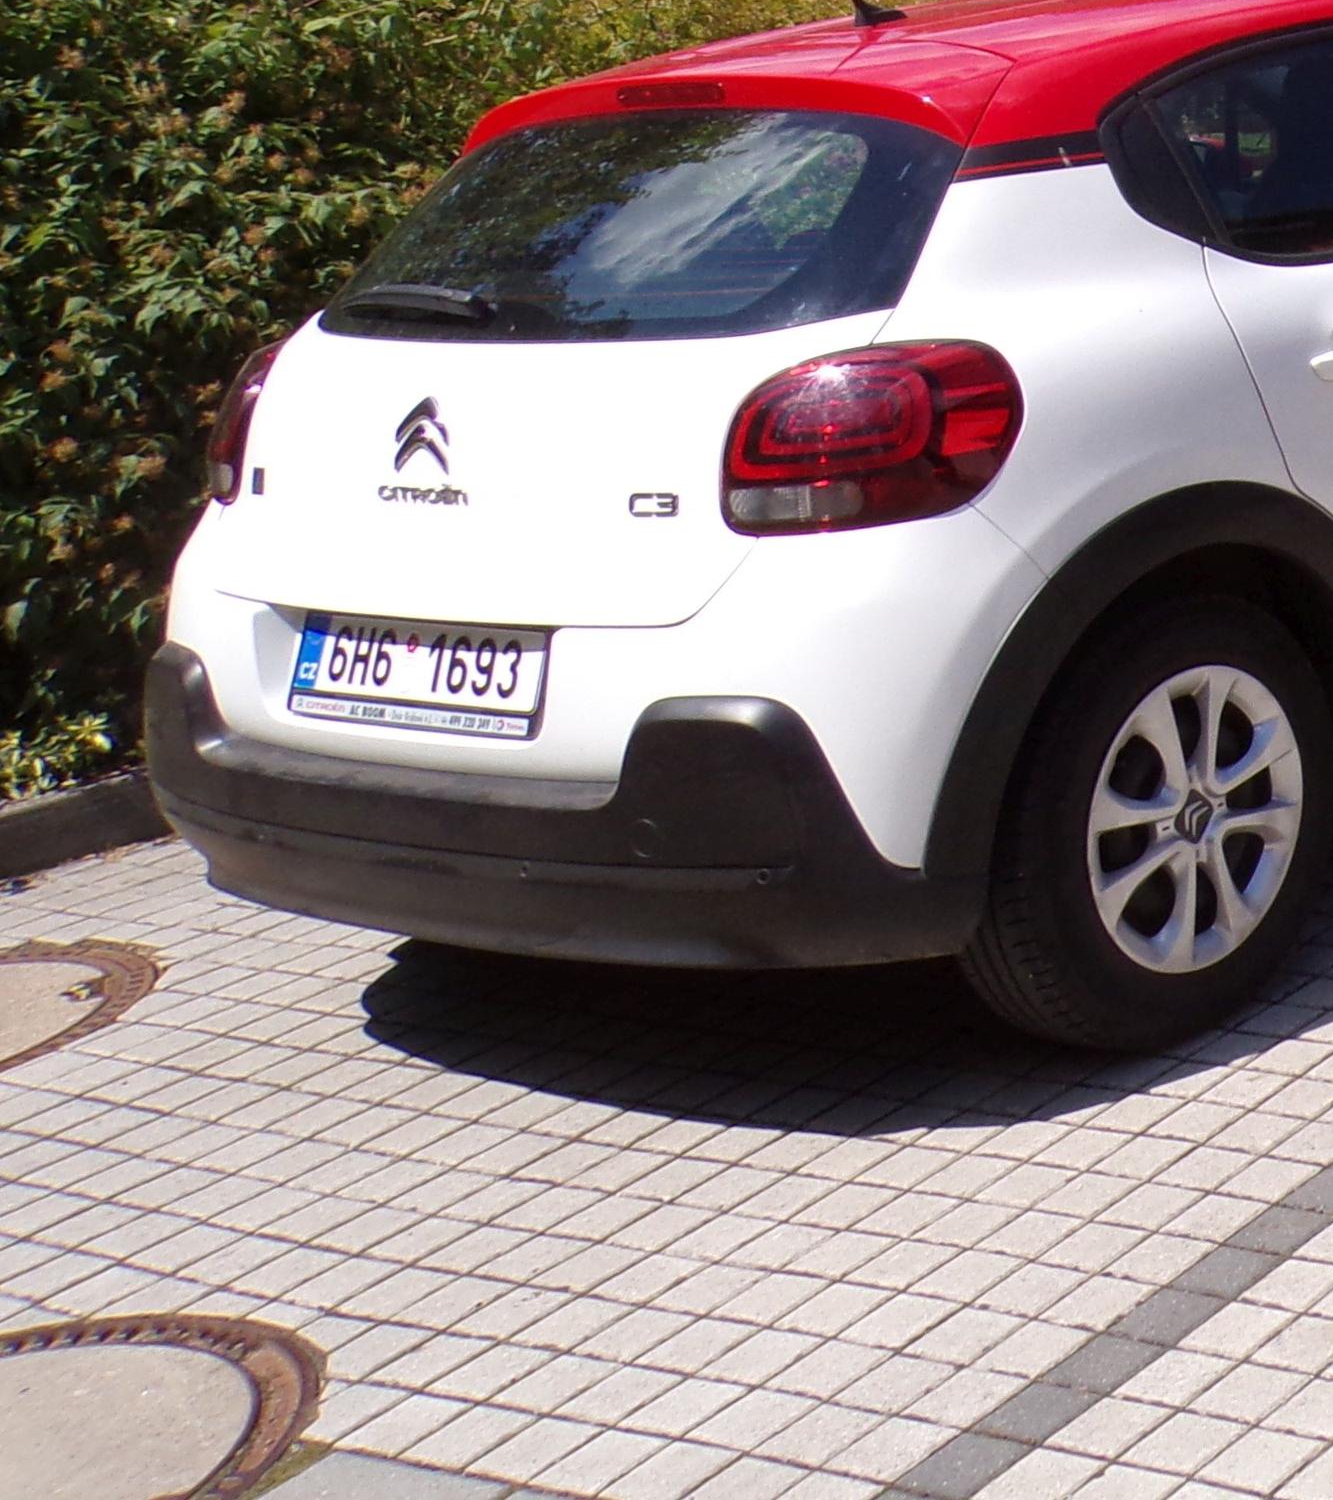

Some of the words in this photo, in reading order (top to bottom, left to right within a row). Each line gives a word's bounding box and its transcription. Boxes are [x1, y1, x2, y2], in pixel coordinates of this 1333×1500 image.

[629, 492, 679, 518] C3
[299, 662, 318, 680] CZ
[328, 625, 397, 687] 6H6
[429, 633, 523, 699] 1693
